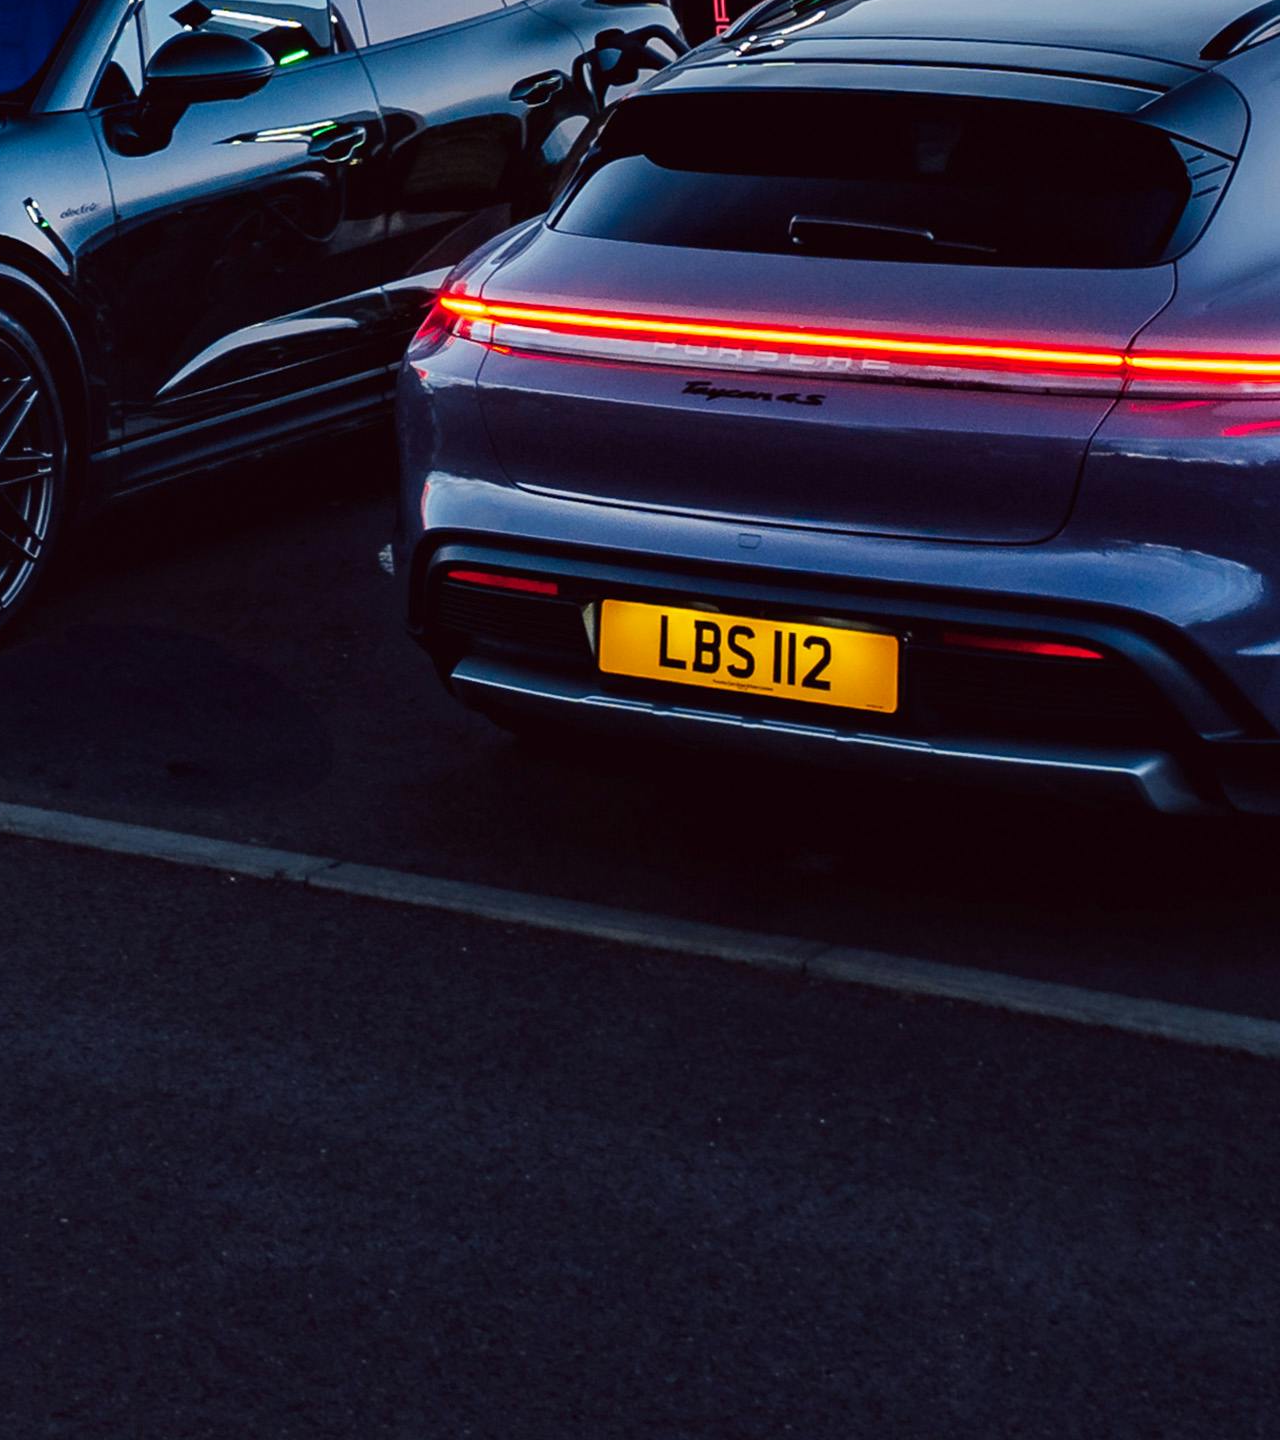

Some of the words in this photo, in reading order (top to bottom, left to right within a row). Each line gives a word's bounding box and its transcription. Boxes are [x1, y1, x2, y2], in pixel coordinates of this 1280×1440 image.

[682, 381, 772, 401] Taycan
[776, 393, 826, 406] 4S
[659, 615, 756, 679] LBS
[773, 630, 832, 691] 112
